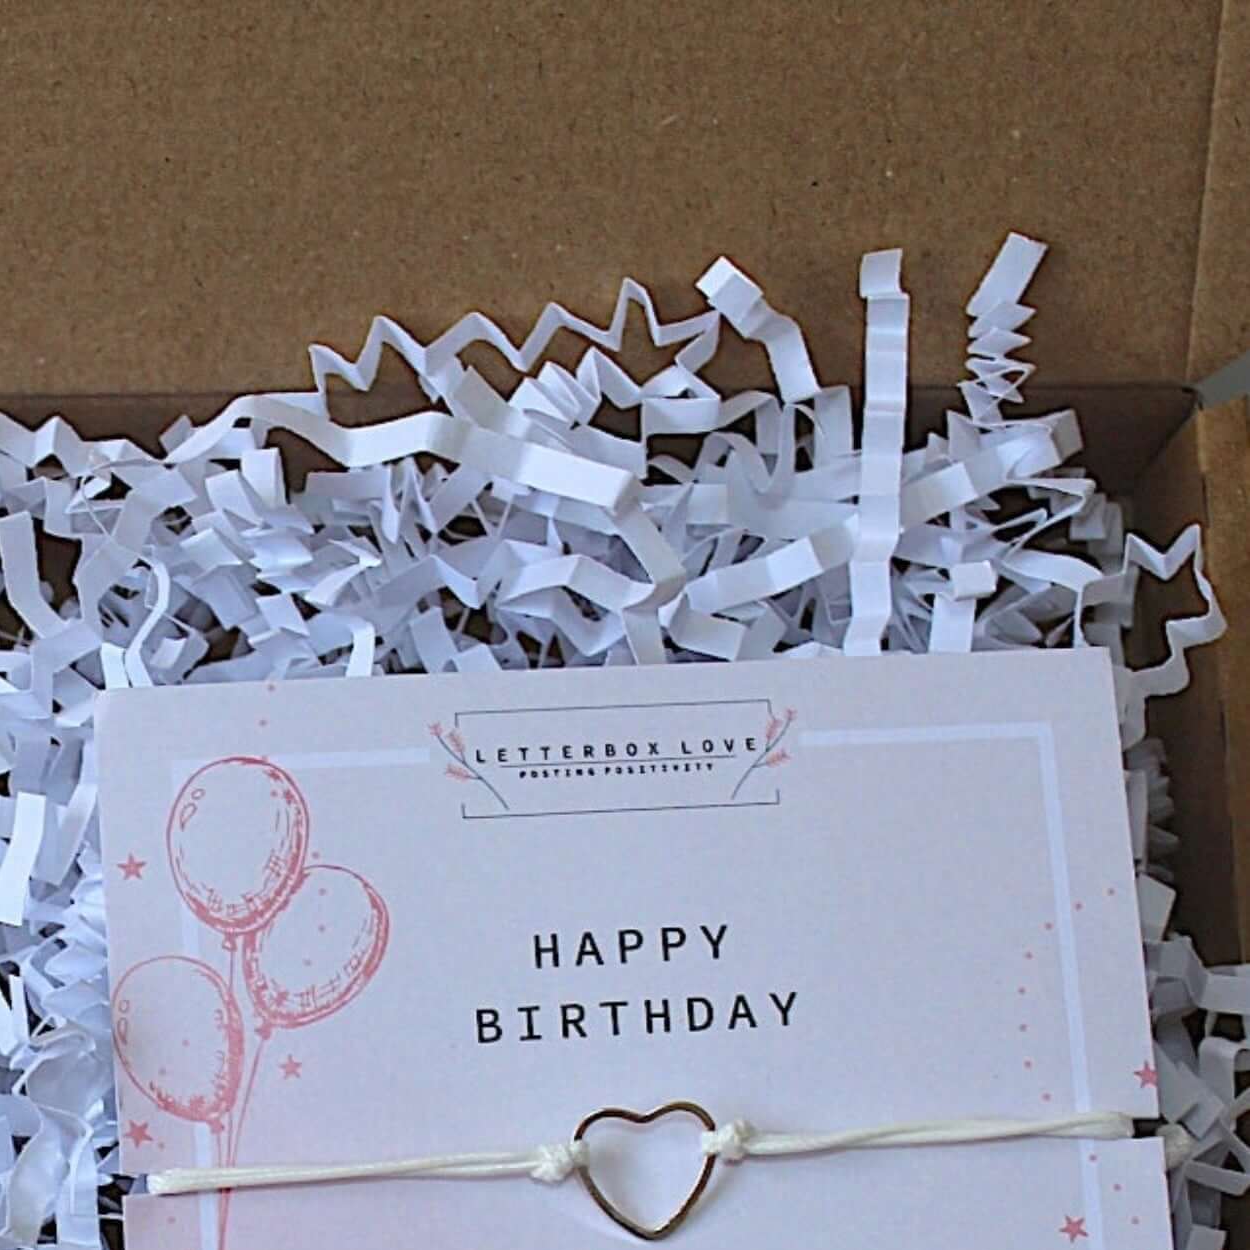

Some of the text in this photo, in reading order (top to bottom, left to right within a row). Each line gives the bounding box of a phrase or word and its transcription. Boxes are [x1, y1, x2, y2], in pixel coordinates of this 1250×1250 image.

[474, 736, 757, 764] LETTERBOX LOVE
[518, 761, 715, 779] POSTING POSITIVITY
[532, 924, 728, 969] HAPPY
[475, 991, 798, 1044] BIRTHDAY
